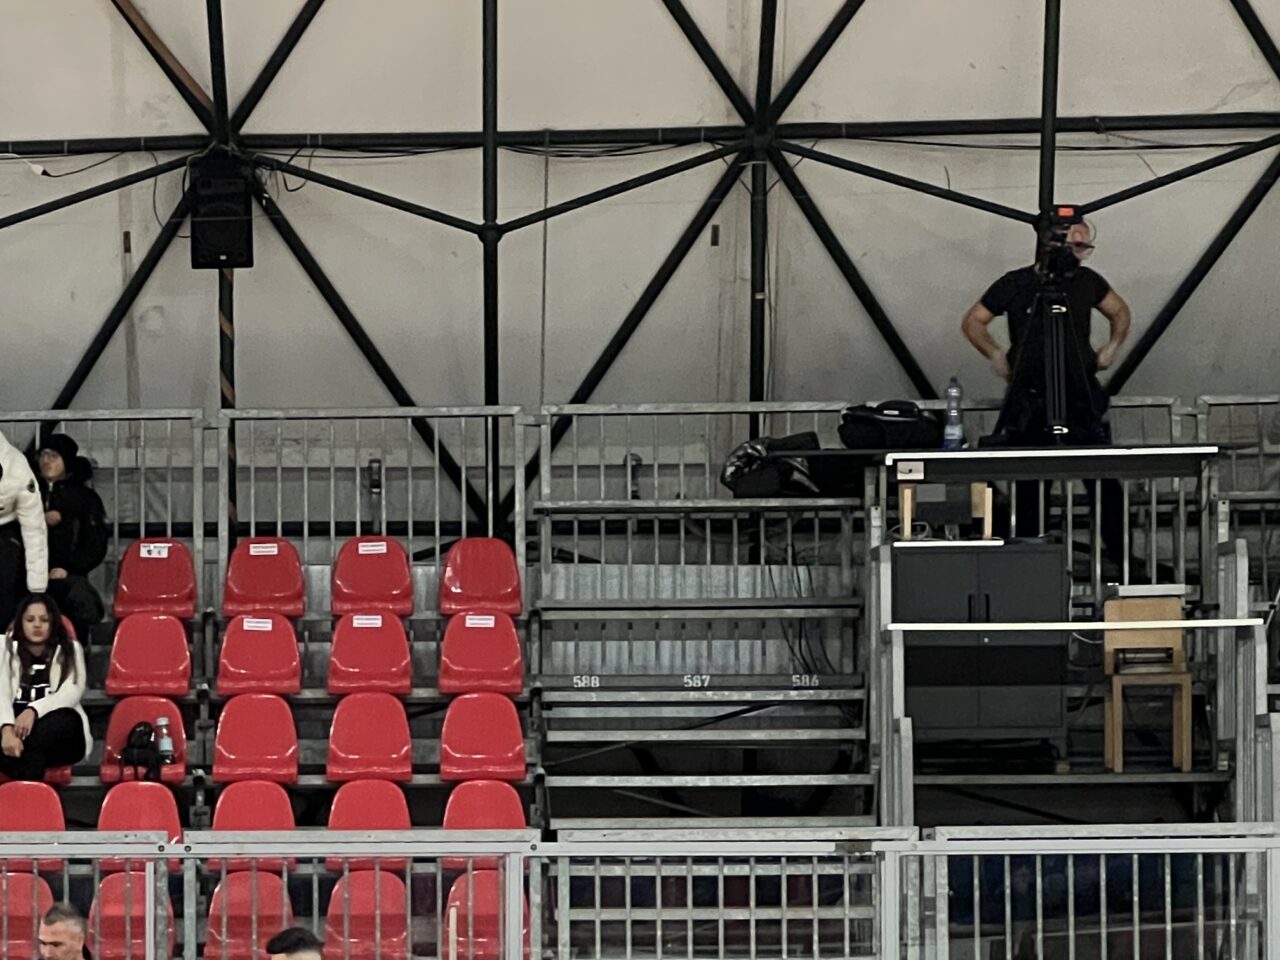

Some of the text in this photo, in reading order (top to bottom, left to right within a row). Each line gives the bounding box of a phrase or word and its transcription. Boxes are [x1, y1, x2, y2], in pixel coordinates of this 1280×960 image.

[573, 675, 600, 688] 588
[683, 675, 710, 688] 587
[792, 674, 819, 687] 586
